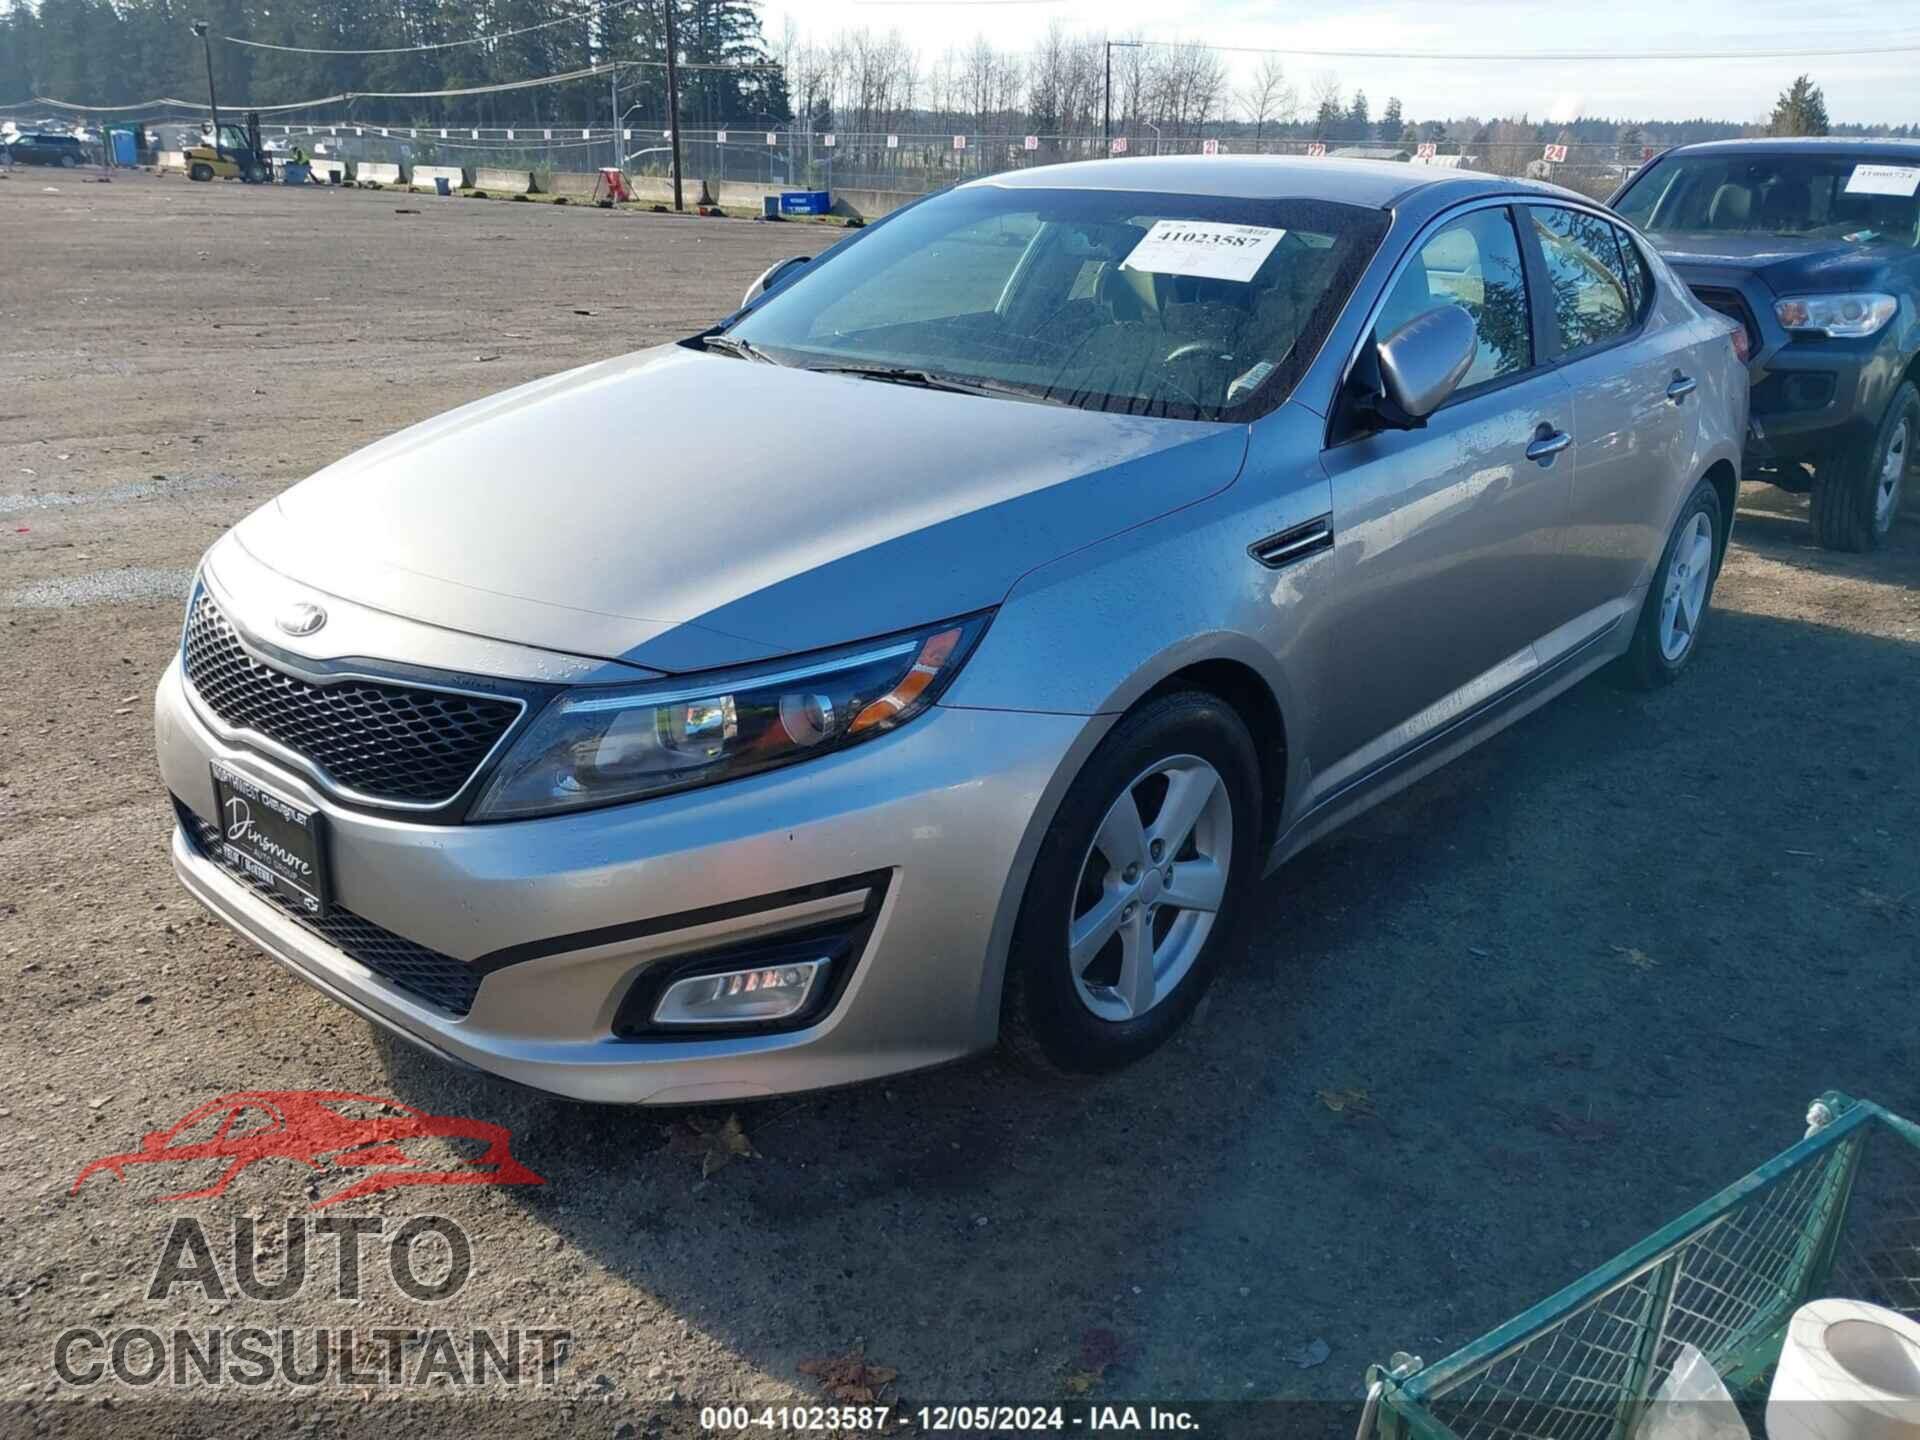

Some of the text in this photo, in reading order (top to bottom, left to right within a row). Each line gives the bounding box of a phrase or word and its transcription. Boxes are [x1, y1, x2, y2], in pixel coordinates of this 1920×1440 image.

[1113, 139, 1126, 152] 20
[1205, 140, 1216, 154] 21
[1310, 144, 1324, 156] 22
[1418, 144, 1434, 158] 23
[1546, 146, 1563, 160] 24
[1158, 231, 1261, 248] 41023587
[225, 795, 312, 876] Dinsmore
